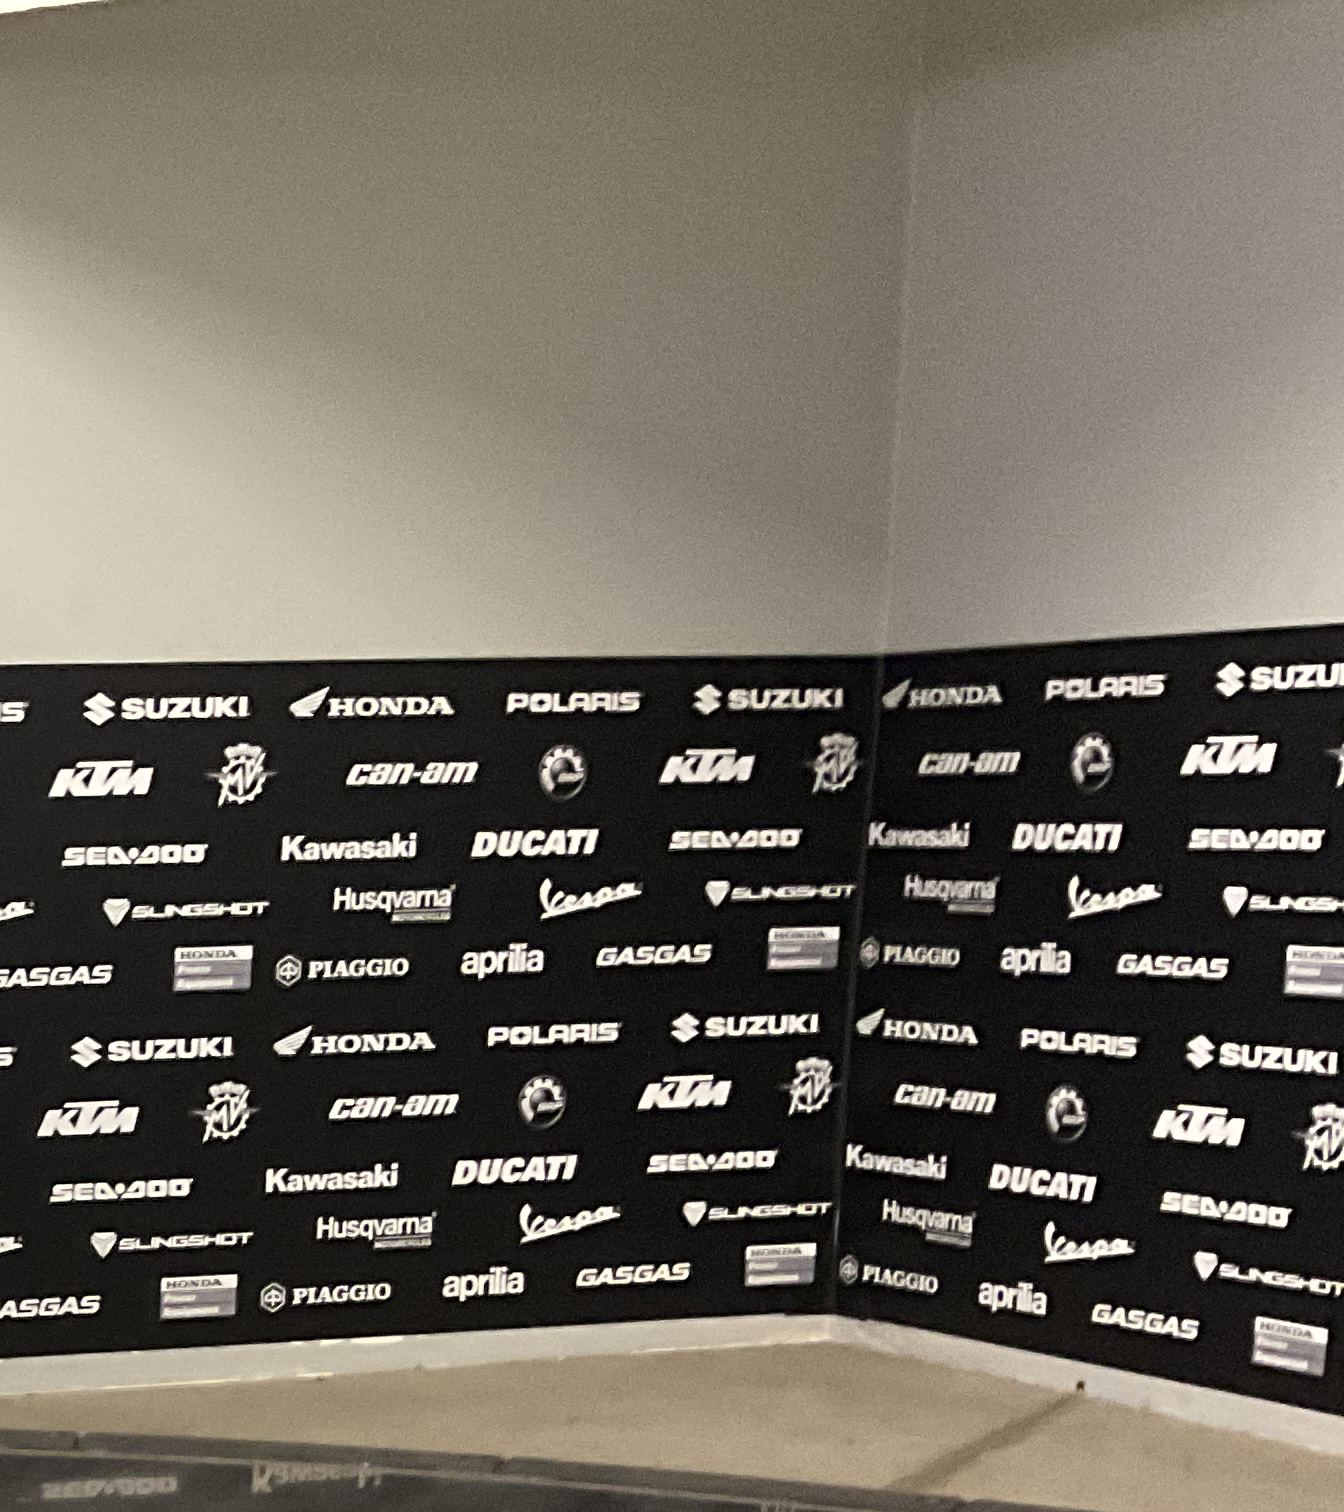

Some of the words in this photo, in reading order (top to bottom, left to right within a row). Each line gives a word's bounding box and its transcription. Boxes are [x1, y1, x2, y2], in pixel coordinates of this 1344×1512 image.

[1045, 674, 1167, 701] POLARIS
[1249, 664, 1344, 690] SUZU
[120, 695, 251, 720] SUZUKI
[327, 696, 456, 717] HONDA
[506, 691, 642, 713] POLARIS
[727, 687, 844, 710] SUZUKI
[907, 684, 1003, 708] HONDA
[658, 748, 756, 784] KTM
[918, 751, 1021, 775] can-am
[1179, 734, 1278, 776] KTM
[47, 759, 154, 798] KTM
[345, 761, 479, 786] can-am
[280, 831, 418, 862] Kawasaki
[470, 828, 600, 858] DUCATI
[868, 821, 971, 848] Kawasaki
[1011, 822, 1123, 852] DUCATI
[333, 884, 457, 913] Husqvarna
[539, 877, 642, 920] Vespa
[730, 882, 857, 900] SLINGSHOT
[903, 874, 1002, 903] Husqvarna
[1067, 874, 1163, 919] Vespa
[130, 901, 271, 919] SLINGSHOT
[180, 949, 237, 961] HONDA
[307, 957, 410, 979] PIAGGIO
[460, 942, 545, 980] aprilia
[595, 943, 713, 967] GASGAS
[883, 945, 961, 966] PIAGGIO
[1000, 941, 1072, 977] aprilia
[1116, 953, 1230, 979] GASGAS
[487, 1022, 622, 1047] POLARIS
[704, 1013, 819, 1038] SUZUKI
[882, 1019, 979, 1045] HONDA
[107, 1036, 234, 1062] SUZUKI
[310, 1031, 437, 1055] HONDA
[1020, 1027, 1139, 1058] POLARIS
[1218, 1042, 1339, 1075] SUZUKI
[328, 1093, 460, 1120] can-am
[637, 1074, 733, 1110] KTM
[893, 1083, 997, 1114] can-am
[36, 1099, 140, 1137] KTM
[1151, 1103, 1246, 1147] KTM
[451, 1154, 579, 1186] DUCATI
[845, 1143, 948, 1180] Kawasaki
[265, 1162, 399, 1193] Kawasaki
[987, 1163, 1098, 1203] DUCATI
[519, 1203, 621, 1244] Vespa
[707, 1202, 833, 1220] SLINGSHOT
[882, 1199, 978, 1235] Husqvarna
[118, 1231, 254, 1251] SLINGSHOT
[315, 1213, 437, 1242] Husqvarna
[1043, 1220, 1135, 1263] Vespa
[166, 1278, 223, 1291] HONDA
[441, 1265, 525, 1302] aprilia
[575, 1262, 691, 1287] GASGAS
[861, 1264, 939, 1294] PIAGGIO
[291, 1282, 392, 1305] PIAGGIO
[978, 1281, 1048, 1316] aprilia
[1091, 1303, 1200, 1340] GASGAS
